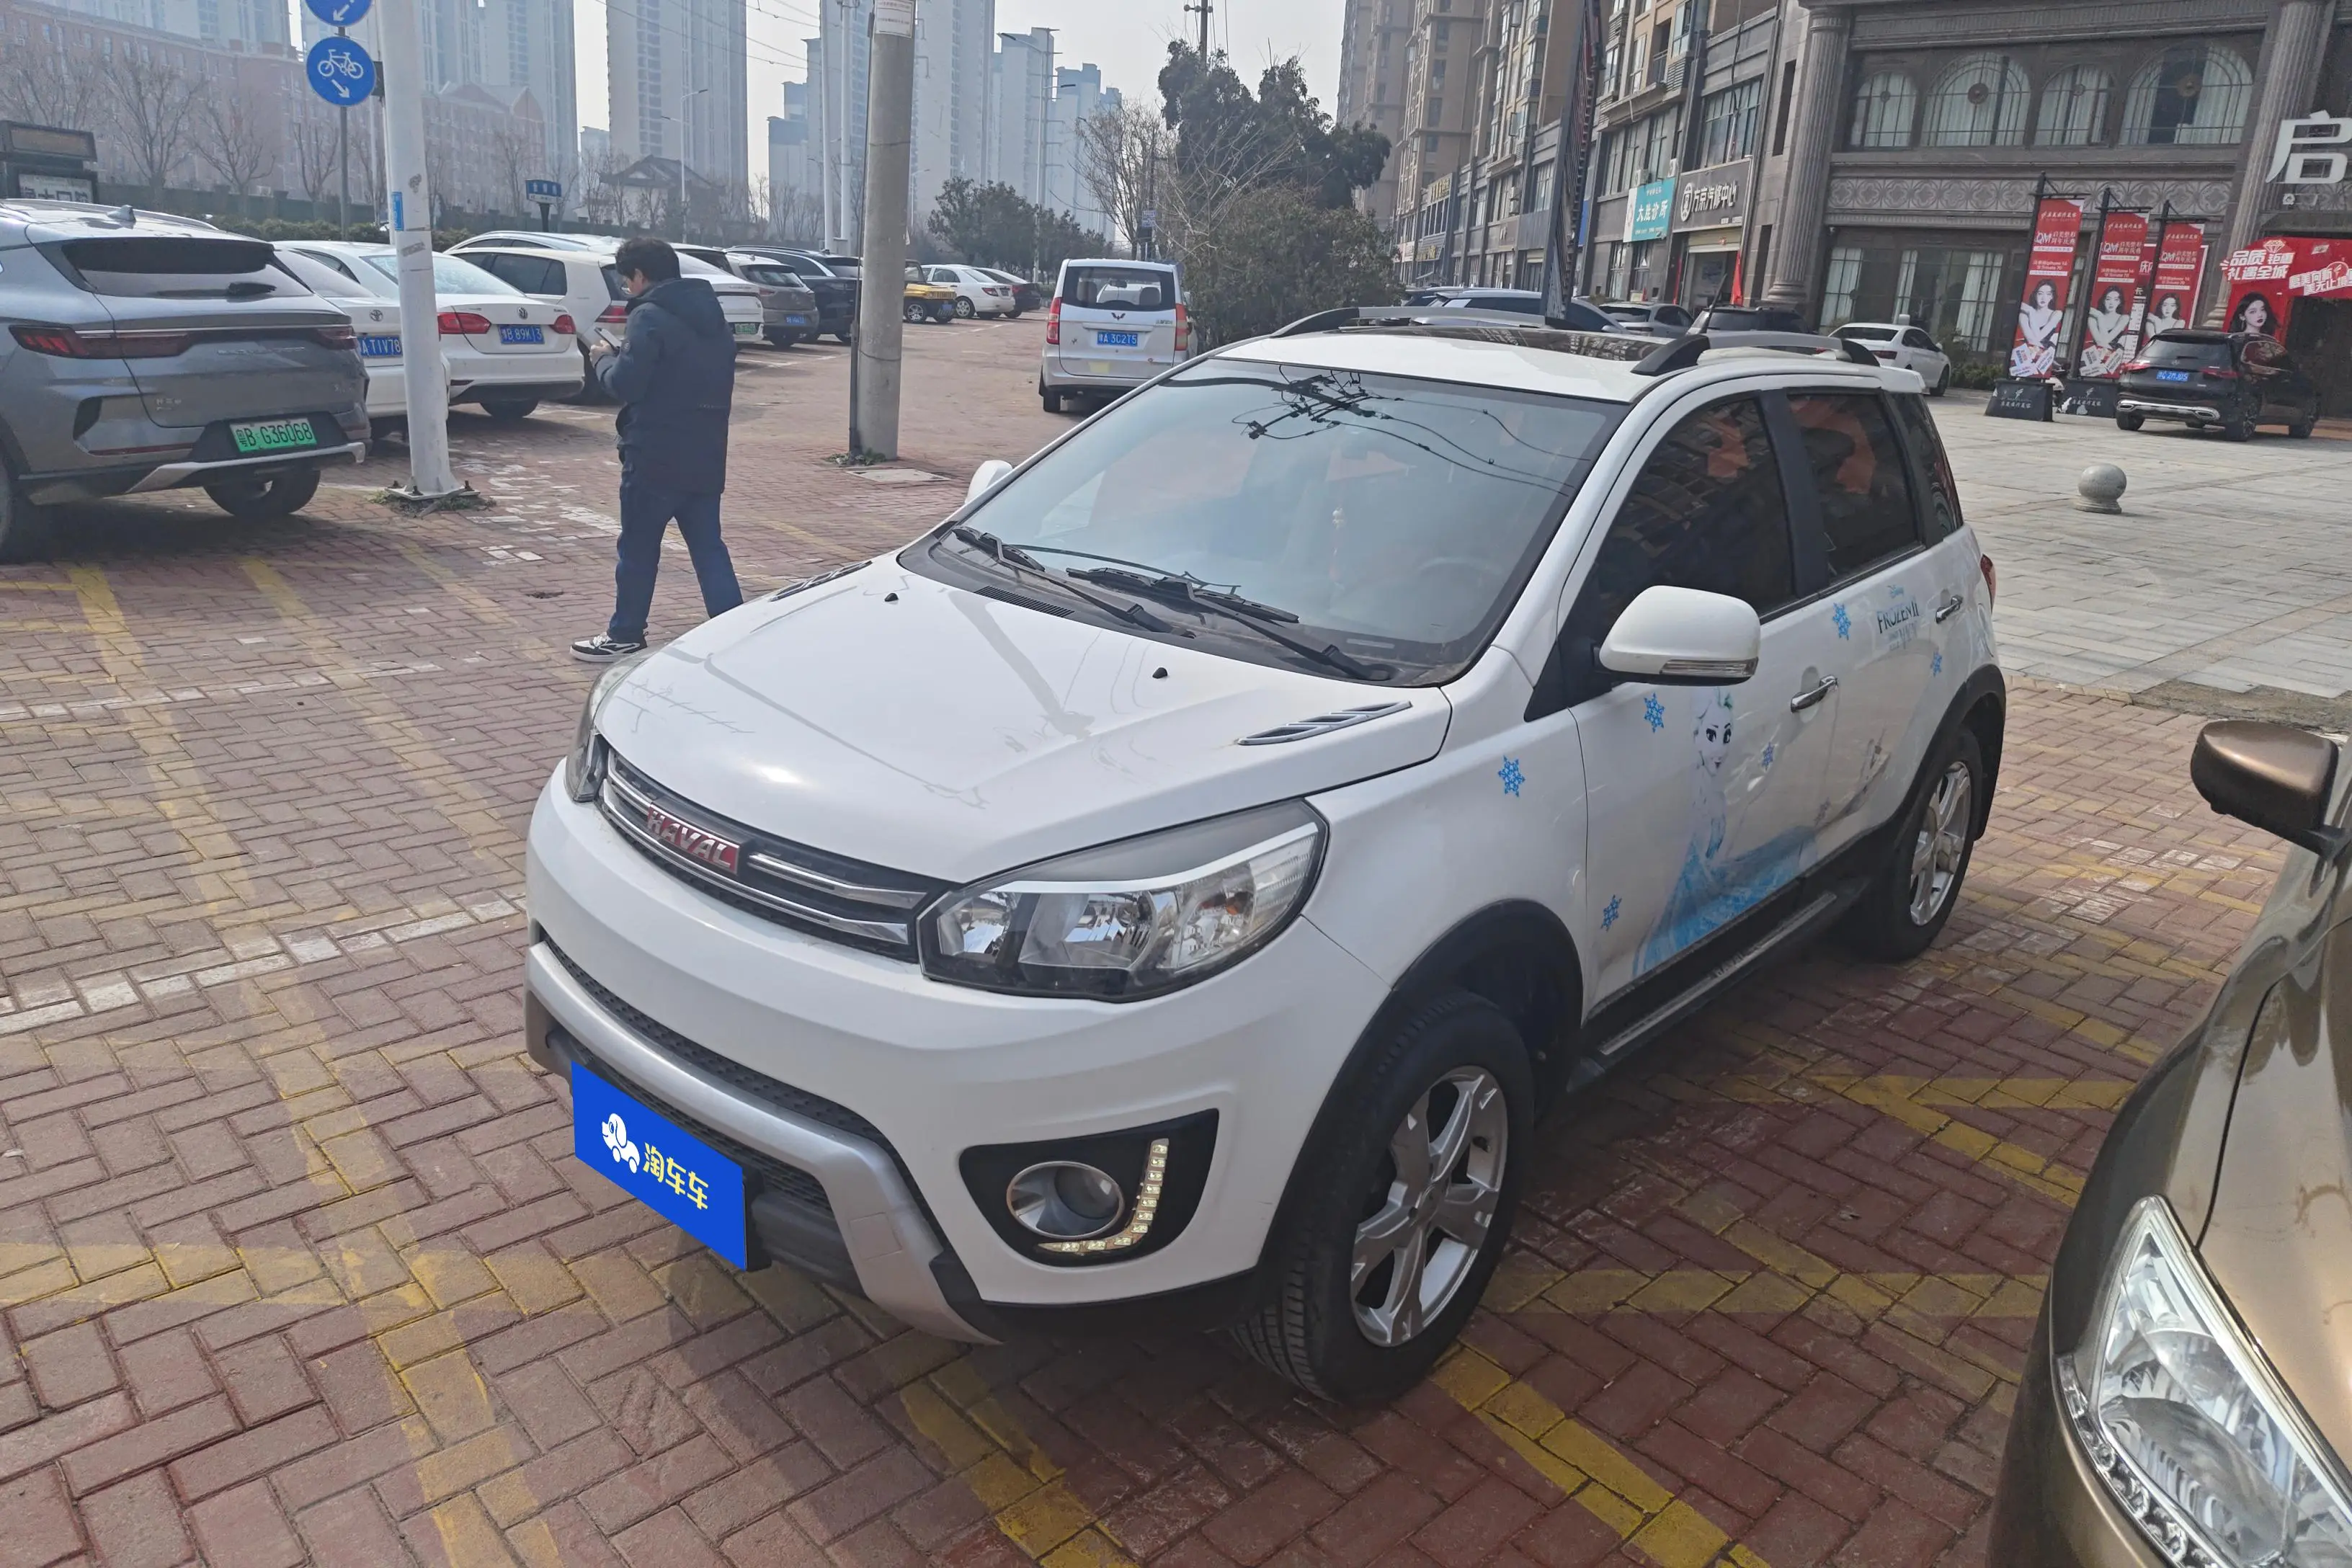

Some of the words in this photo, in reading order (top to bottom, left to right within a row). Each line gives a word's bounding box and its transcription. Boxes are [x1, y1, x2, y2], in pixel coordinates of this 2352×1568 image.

[2265, 109, 2352, 184] 启
[2227, 265, 2289, 280] 礼遇全城
[2230, 249, 2266, 266] 品质
[648, 811, 731, 869] HAVAL
